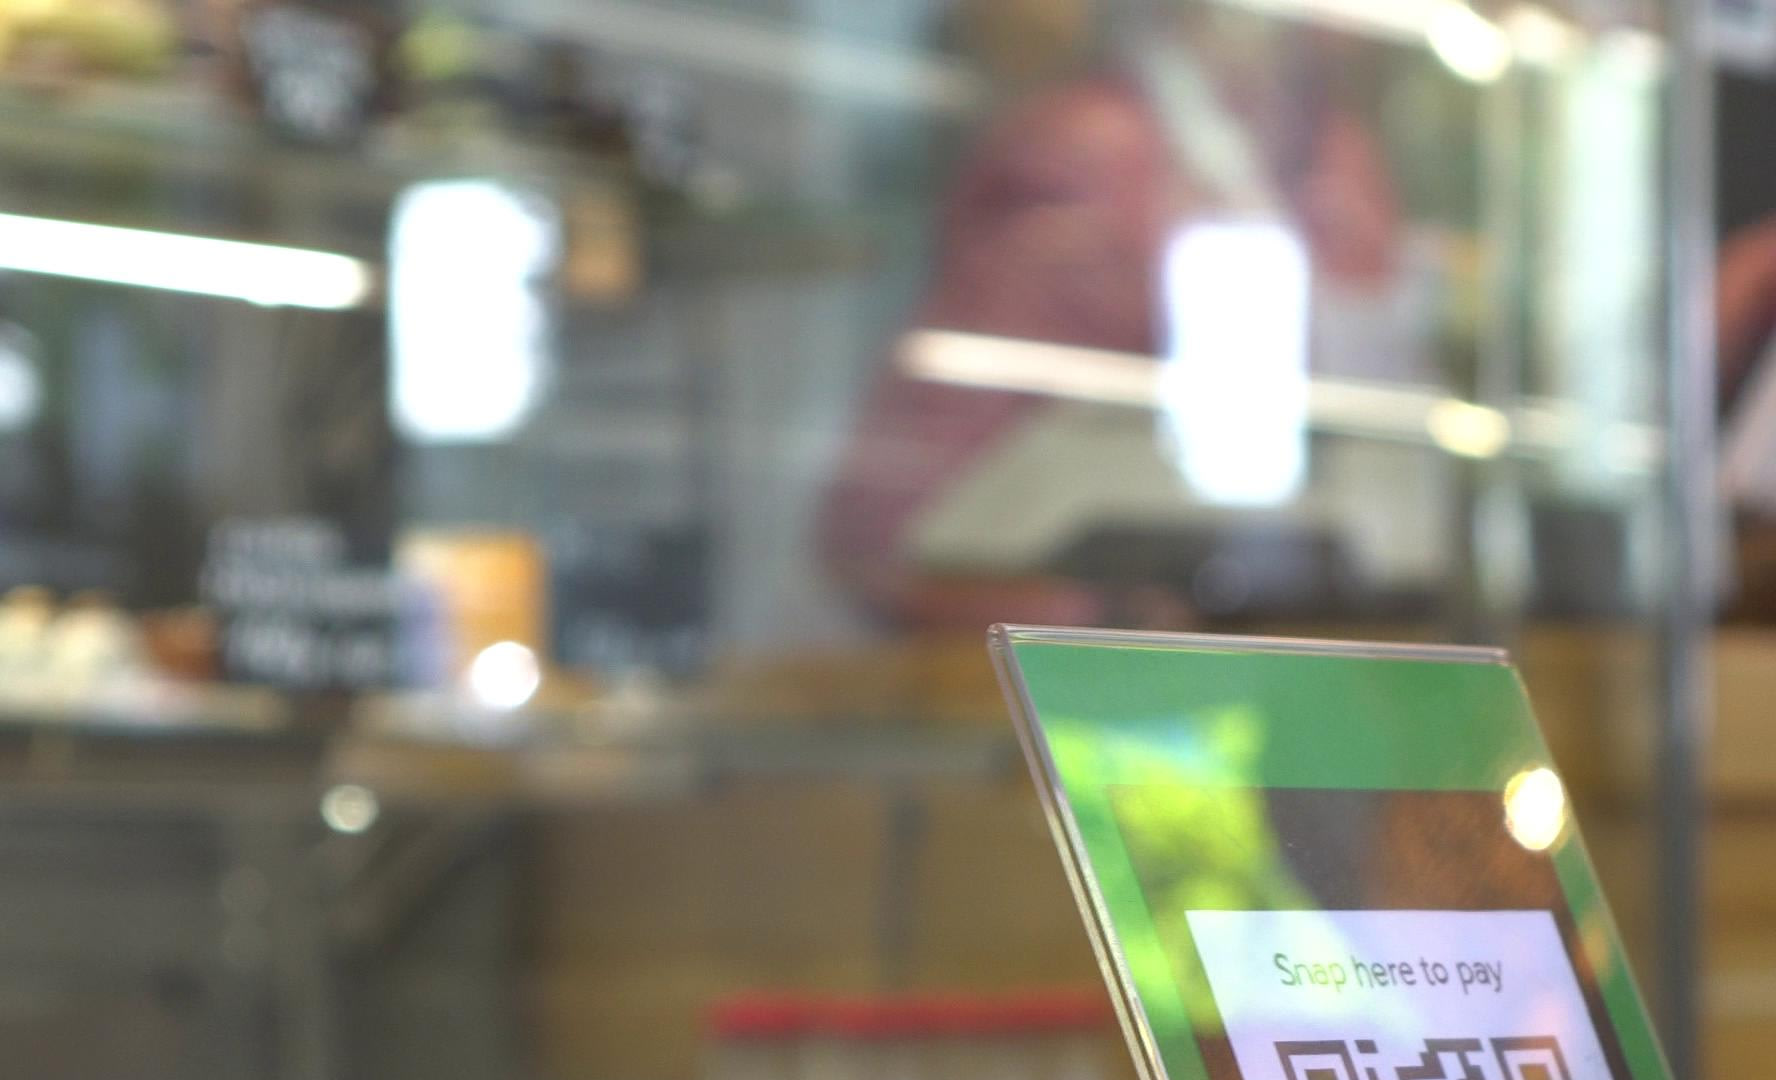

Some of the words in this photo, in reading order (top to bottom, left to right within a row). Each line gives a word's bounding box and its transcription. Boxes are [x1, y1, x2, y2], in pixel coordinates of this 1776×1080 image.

[1273, 952, 1347, 992] Snap
[1352, 955, 1416, 989] here
[1420, 957, 1450, 987] to
[1455, 959, 1504, 994] pay
